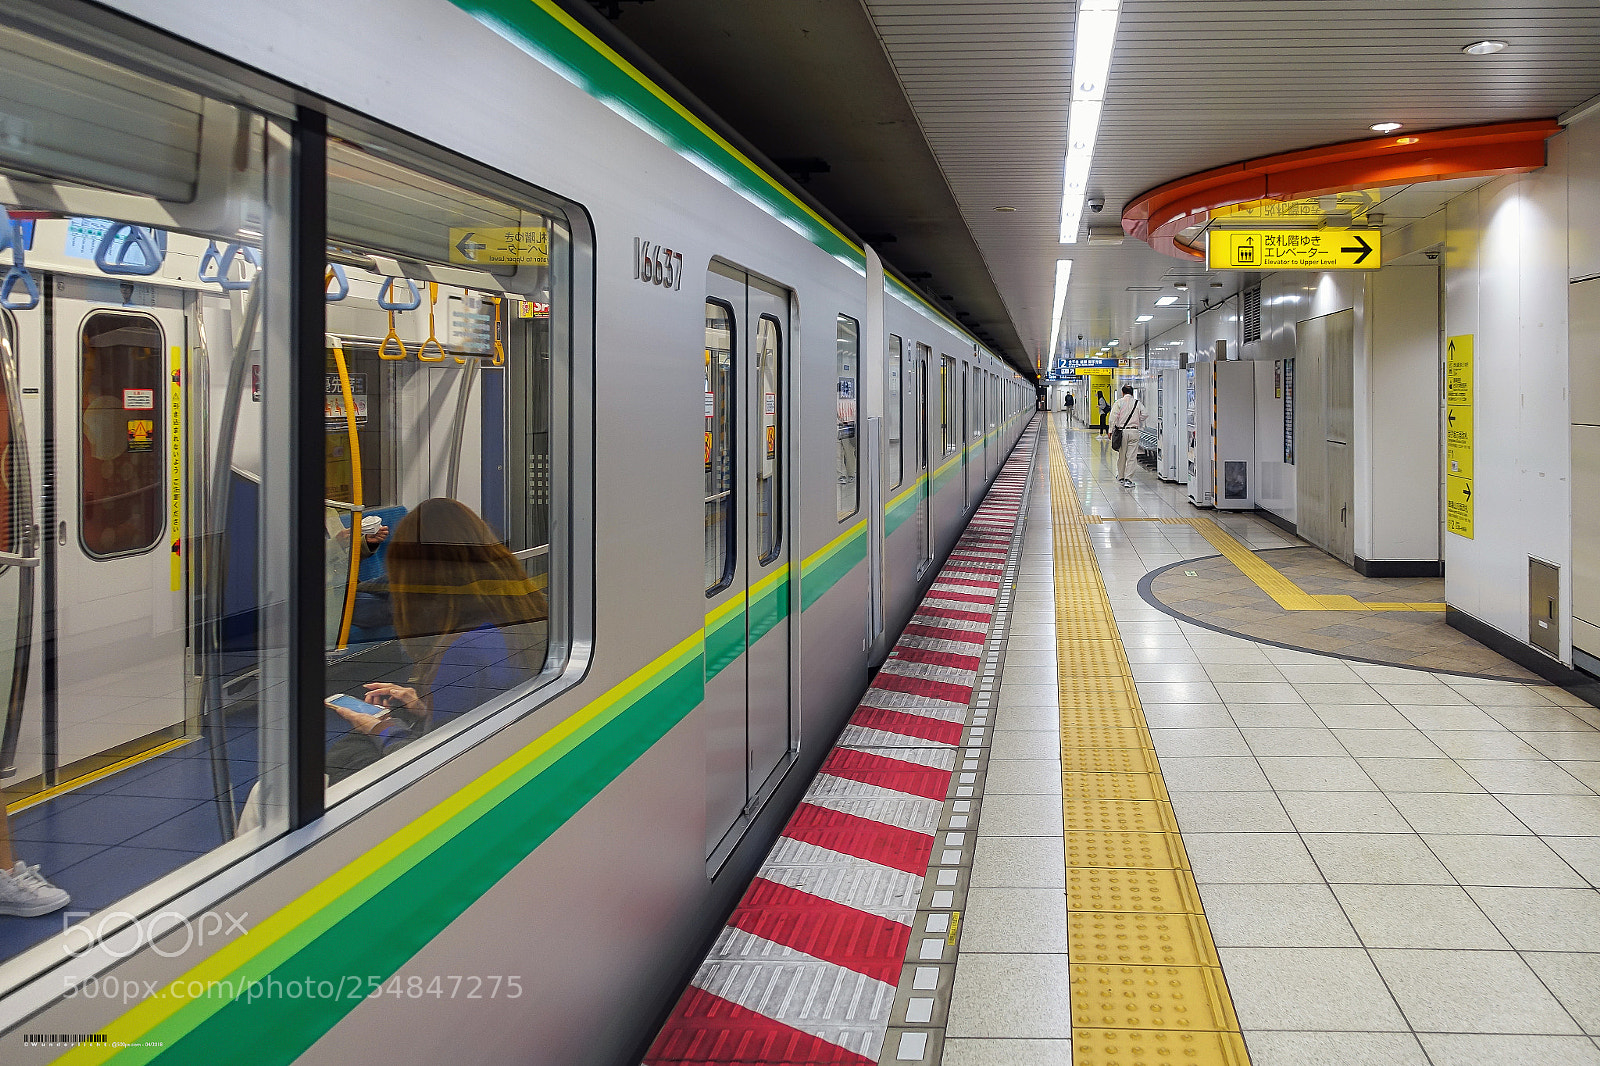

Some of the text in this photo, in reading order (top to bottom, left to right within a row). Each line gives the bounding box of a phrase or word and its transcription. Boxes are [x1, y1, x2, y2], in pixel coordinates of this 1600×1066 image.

[1264, 235, 1321, 246] 改札階ゆき
[1264, 247, 1328, 258] エレベーター
[633, 236, 683, 291] 16637
[1060, 359, 1067, 367] 2
